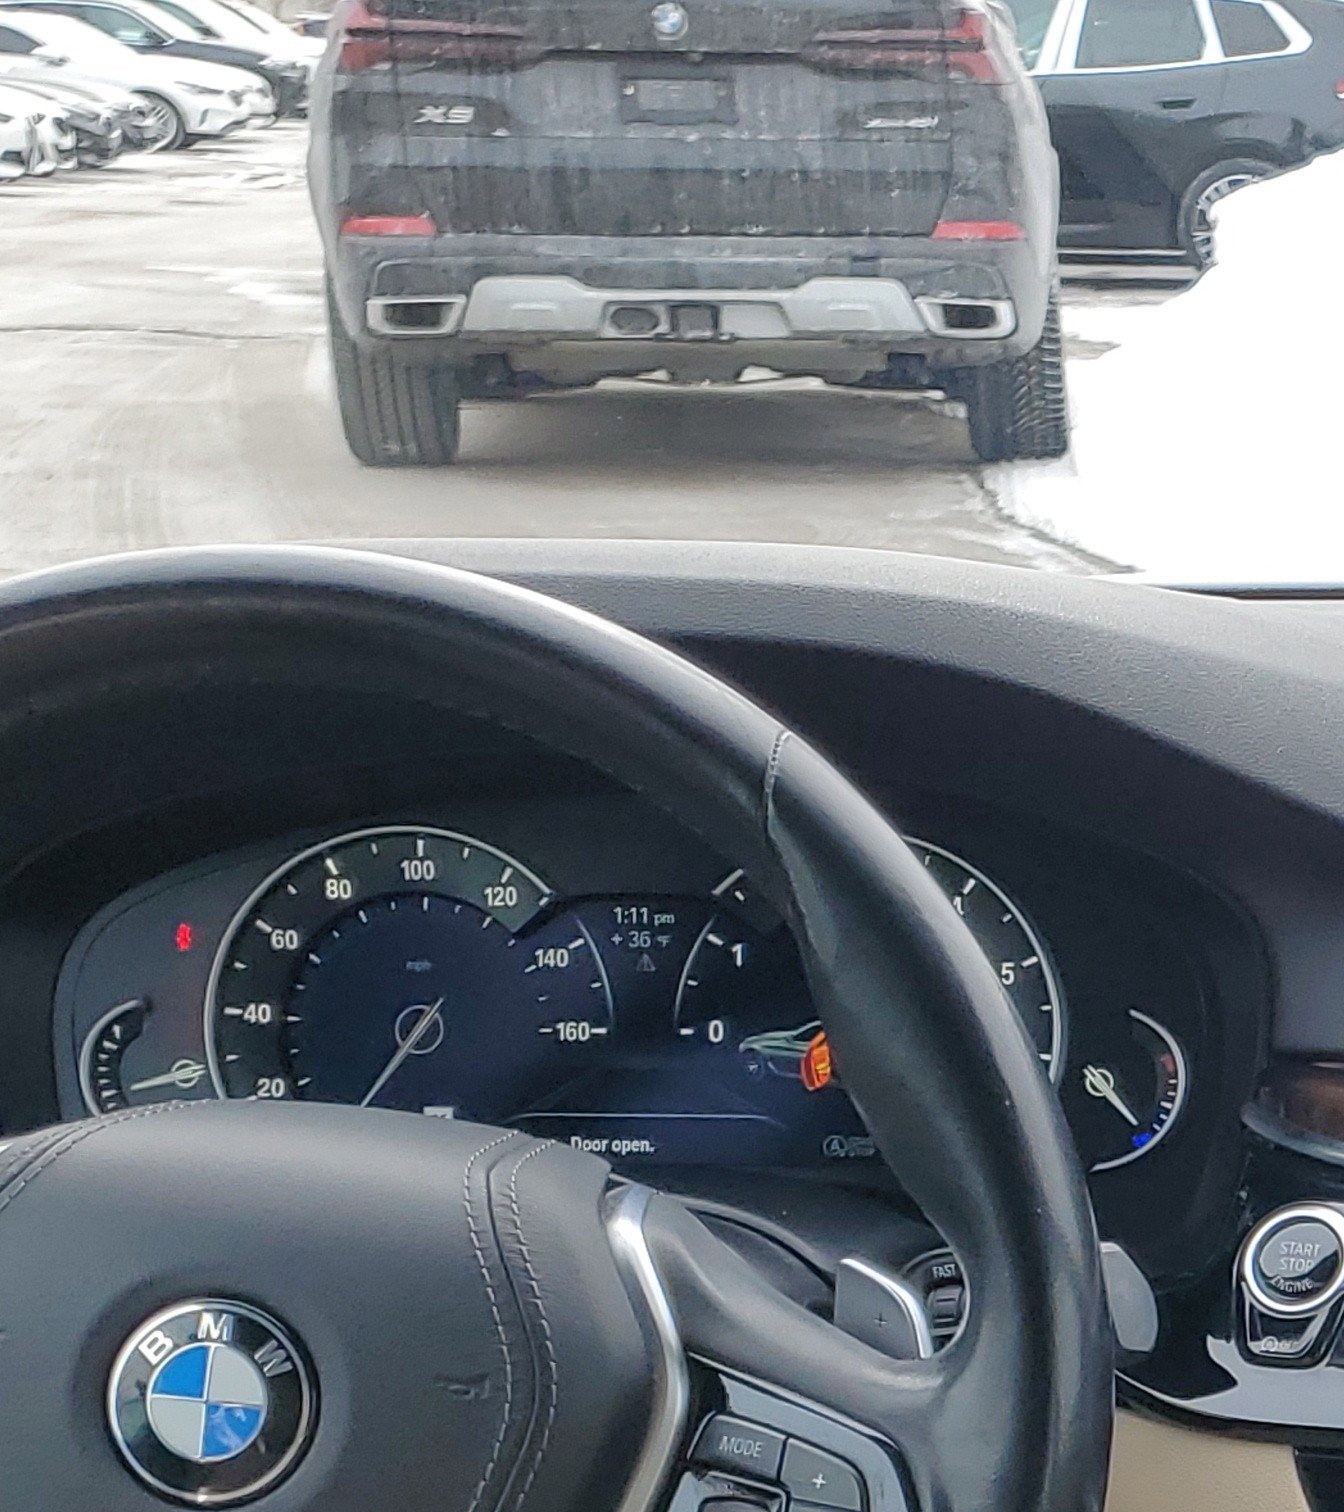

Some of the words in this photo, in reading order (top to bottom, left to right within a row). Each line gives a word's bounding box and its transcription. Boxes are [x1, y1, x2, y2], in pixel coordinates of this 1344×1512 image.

[138, 311, 294, 378] BMW
[400, 859, 435, 882] 100
[325, 879, 352, 900] 80
[484, 886, 517, 908] 120
[612, 906, 648, 924] 1:11
[653, 913, 675, 927] pm
[271, 929, 299, 950] 60
[628, 930, 652, 948] 36
[534, 946, 569, 969] 140
[731, 943, 744, 968] 1
[1001, 962, 1016, 986] 5
[243, 1003, 271, 1024] 40
[556, 1021, 590, 1043] 160
[708, 1019, 725, 1043] 0
[257, 1077, 286, 1098] 20
[570, 1135, 609, 1152] Door
[1279, 1240, 1321, 1256] START
[931, 1263, 957, 1279] FAST
[1279, 1257, 1315, 1273] STOP
[1271, 1274, 1315, 1293] ENGINE
[718, 1435, 765, 1458] MODE
